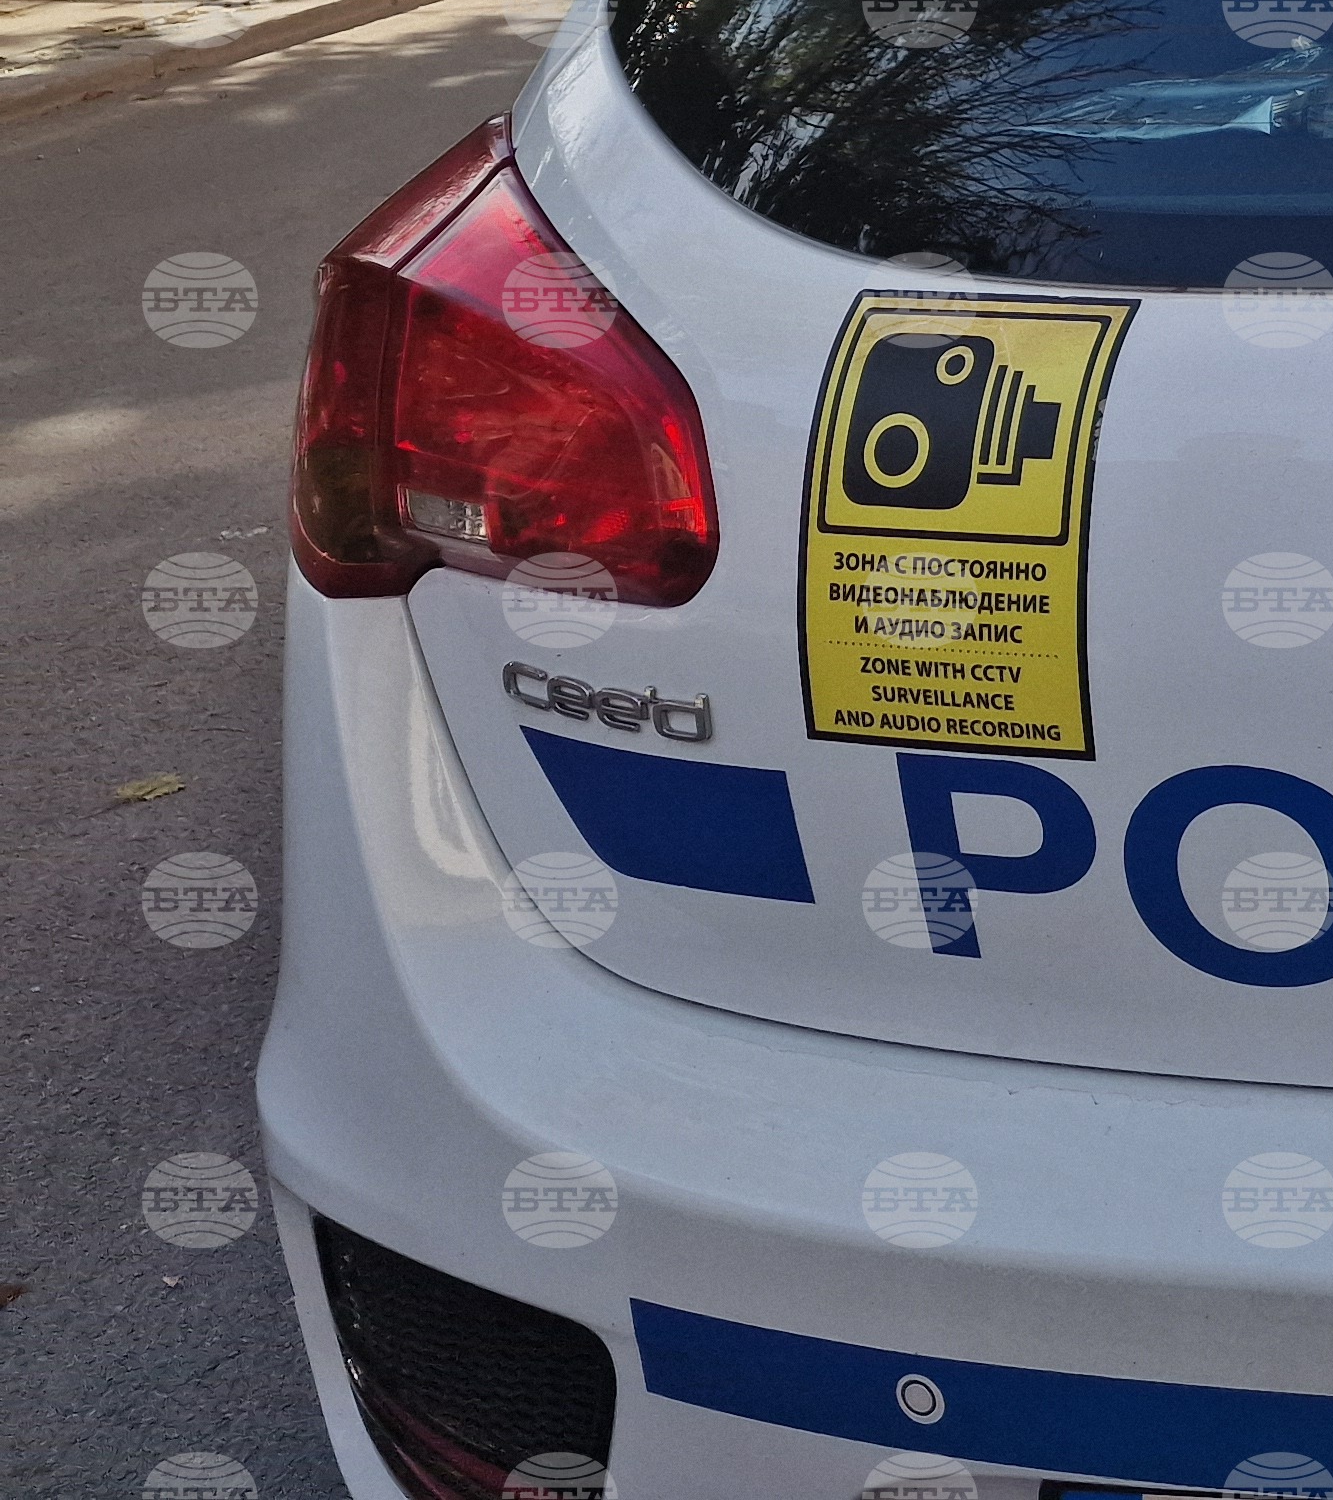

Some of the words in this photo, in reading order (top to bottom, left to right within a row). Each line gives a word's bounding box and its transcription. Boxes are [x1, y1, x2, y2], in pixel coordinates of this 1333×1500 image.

[833, 552, 889, 574] ЗОНА
[894, 555, 908, 575] С
[912, 556, 1047, 582] ПОСТОЯННО
[829, 582, 1050, 615] ВИДЕОНАБЛЮДЕНИЕ
[854, 615, 869, 635] И
[874, 617, 946, 640] АУДИО
[951, 621, 1023, 644] ЗАПИС
[860, 656, 912, 677] ZONE
[914, 660, 966, 680] WITH
[970, 663, 1022, 683] CCTV
[872, 685, 1015, 711] SURVEILLANCE
[834, 709, 875, 728] AND
[880, 712, 941, 733] AUDIO
[946, 717, 1062, 742] RECORDING
